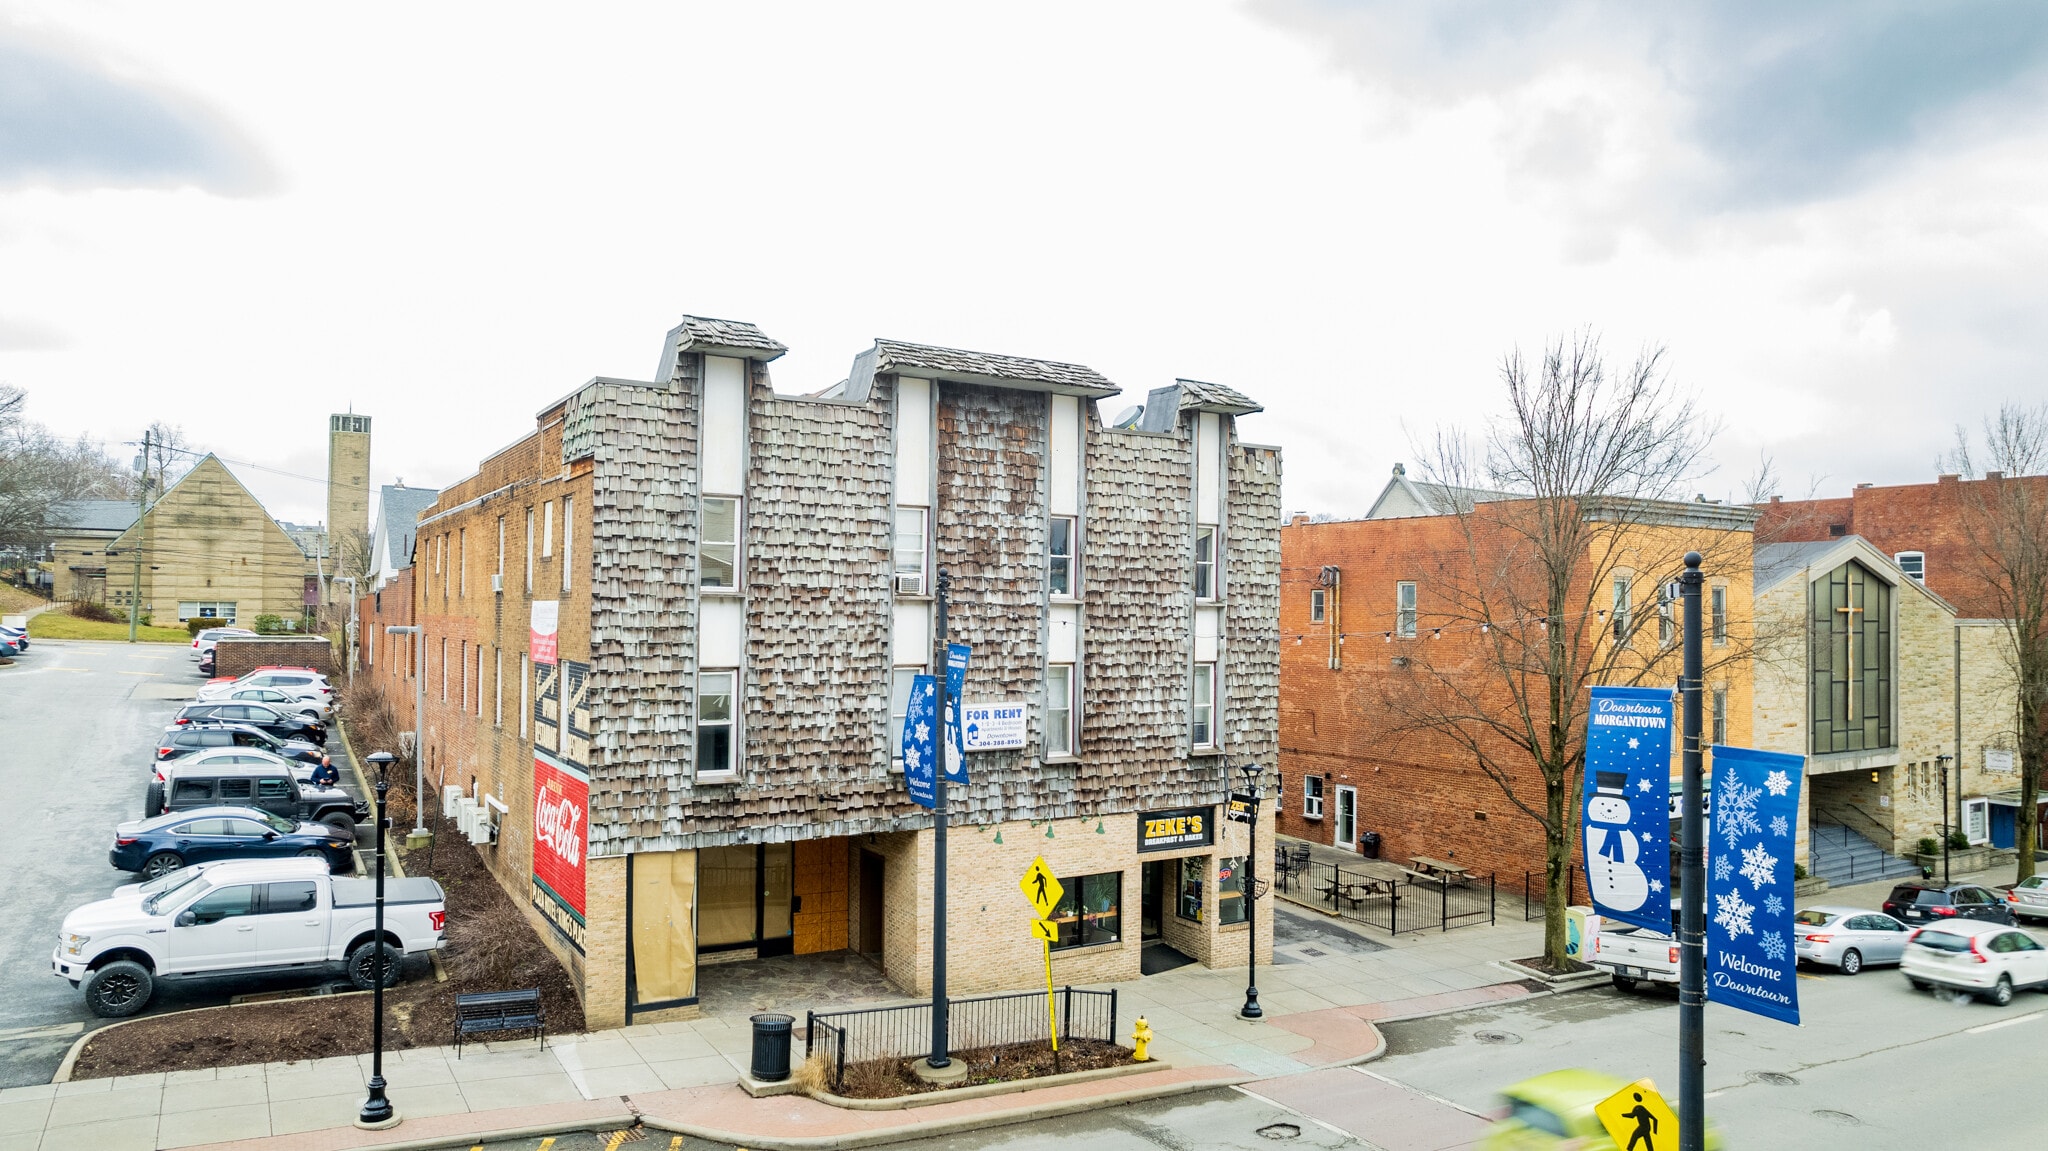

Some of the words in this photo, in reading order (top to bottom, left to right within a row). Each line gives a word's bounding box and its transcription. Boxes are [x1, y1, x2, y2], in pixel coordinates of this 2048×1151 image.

[966, 710, 988, 720] FOR
[994, 708, 1022, 719] RENT
[1598, 699, 1663, 715] Downtown
[1594, 714, 1666, 728] MORGANTOWN
[908, 776, 930, 789] Welcome
[1145, 815, 1203, 838] ZEKE'S
[1144, 836, 1177, 846] BREAKFAST
[1719, 950, 1782, 982] Welcome
[1713, 971, 1792, 1005] Downtown
